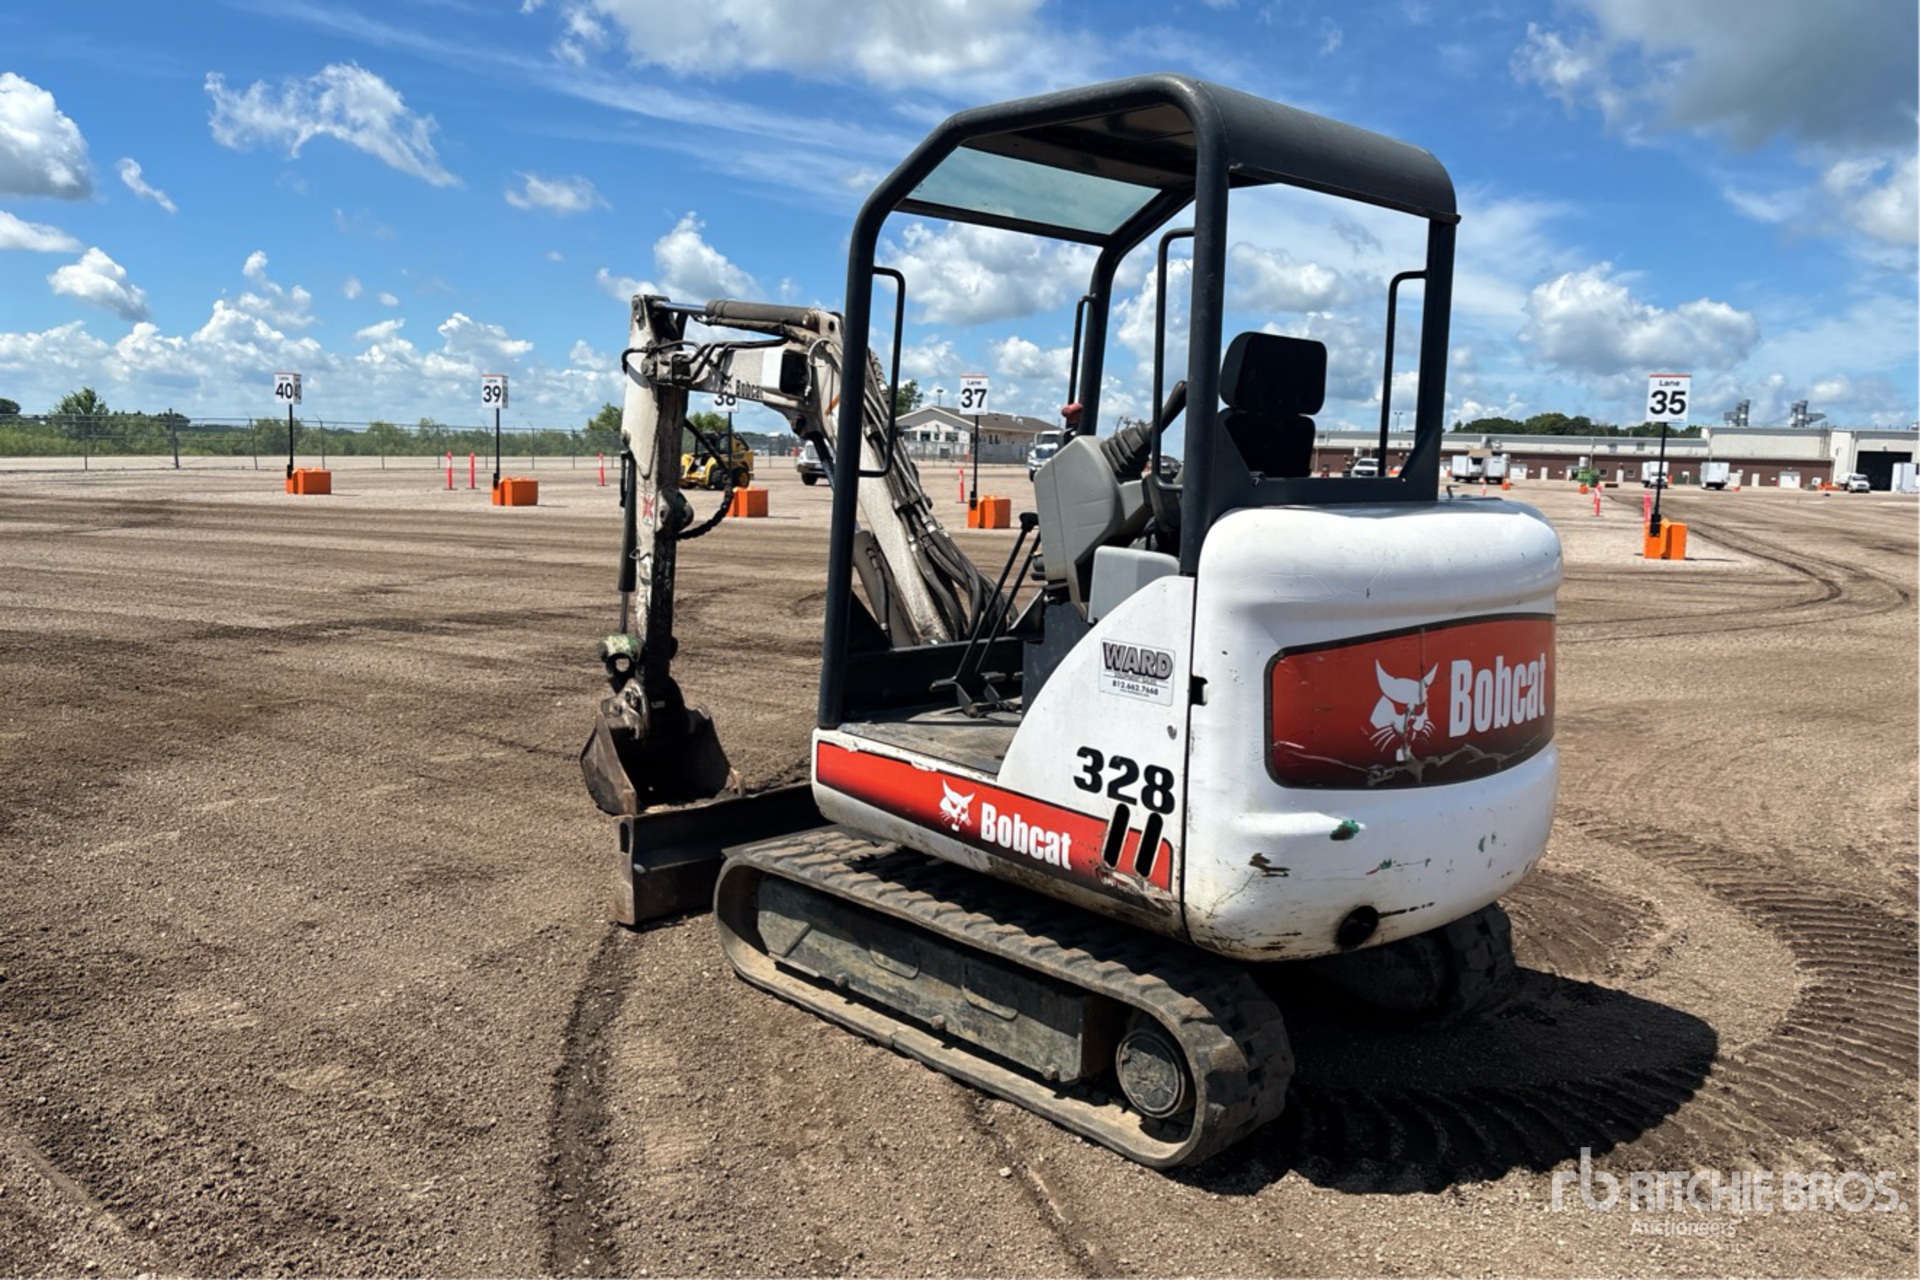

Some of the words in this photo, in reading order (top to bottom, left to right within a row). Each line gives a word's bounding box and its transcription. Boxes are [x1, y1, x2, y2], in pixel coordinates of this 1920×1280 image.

[275, 382, 294, 399] 40
[483, 385, 502, 403] 39
[961, 388, 987, 409] 37
[1649, 390, 1686, 415] 35
[1102, 642, 1174, 681] WARD
[1448, 652, 1547, 738] Bobcat
[1073, 746, 1176, 815] 328
[980, 802, 1072, 870] Bobcat
